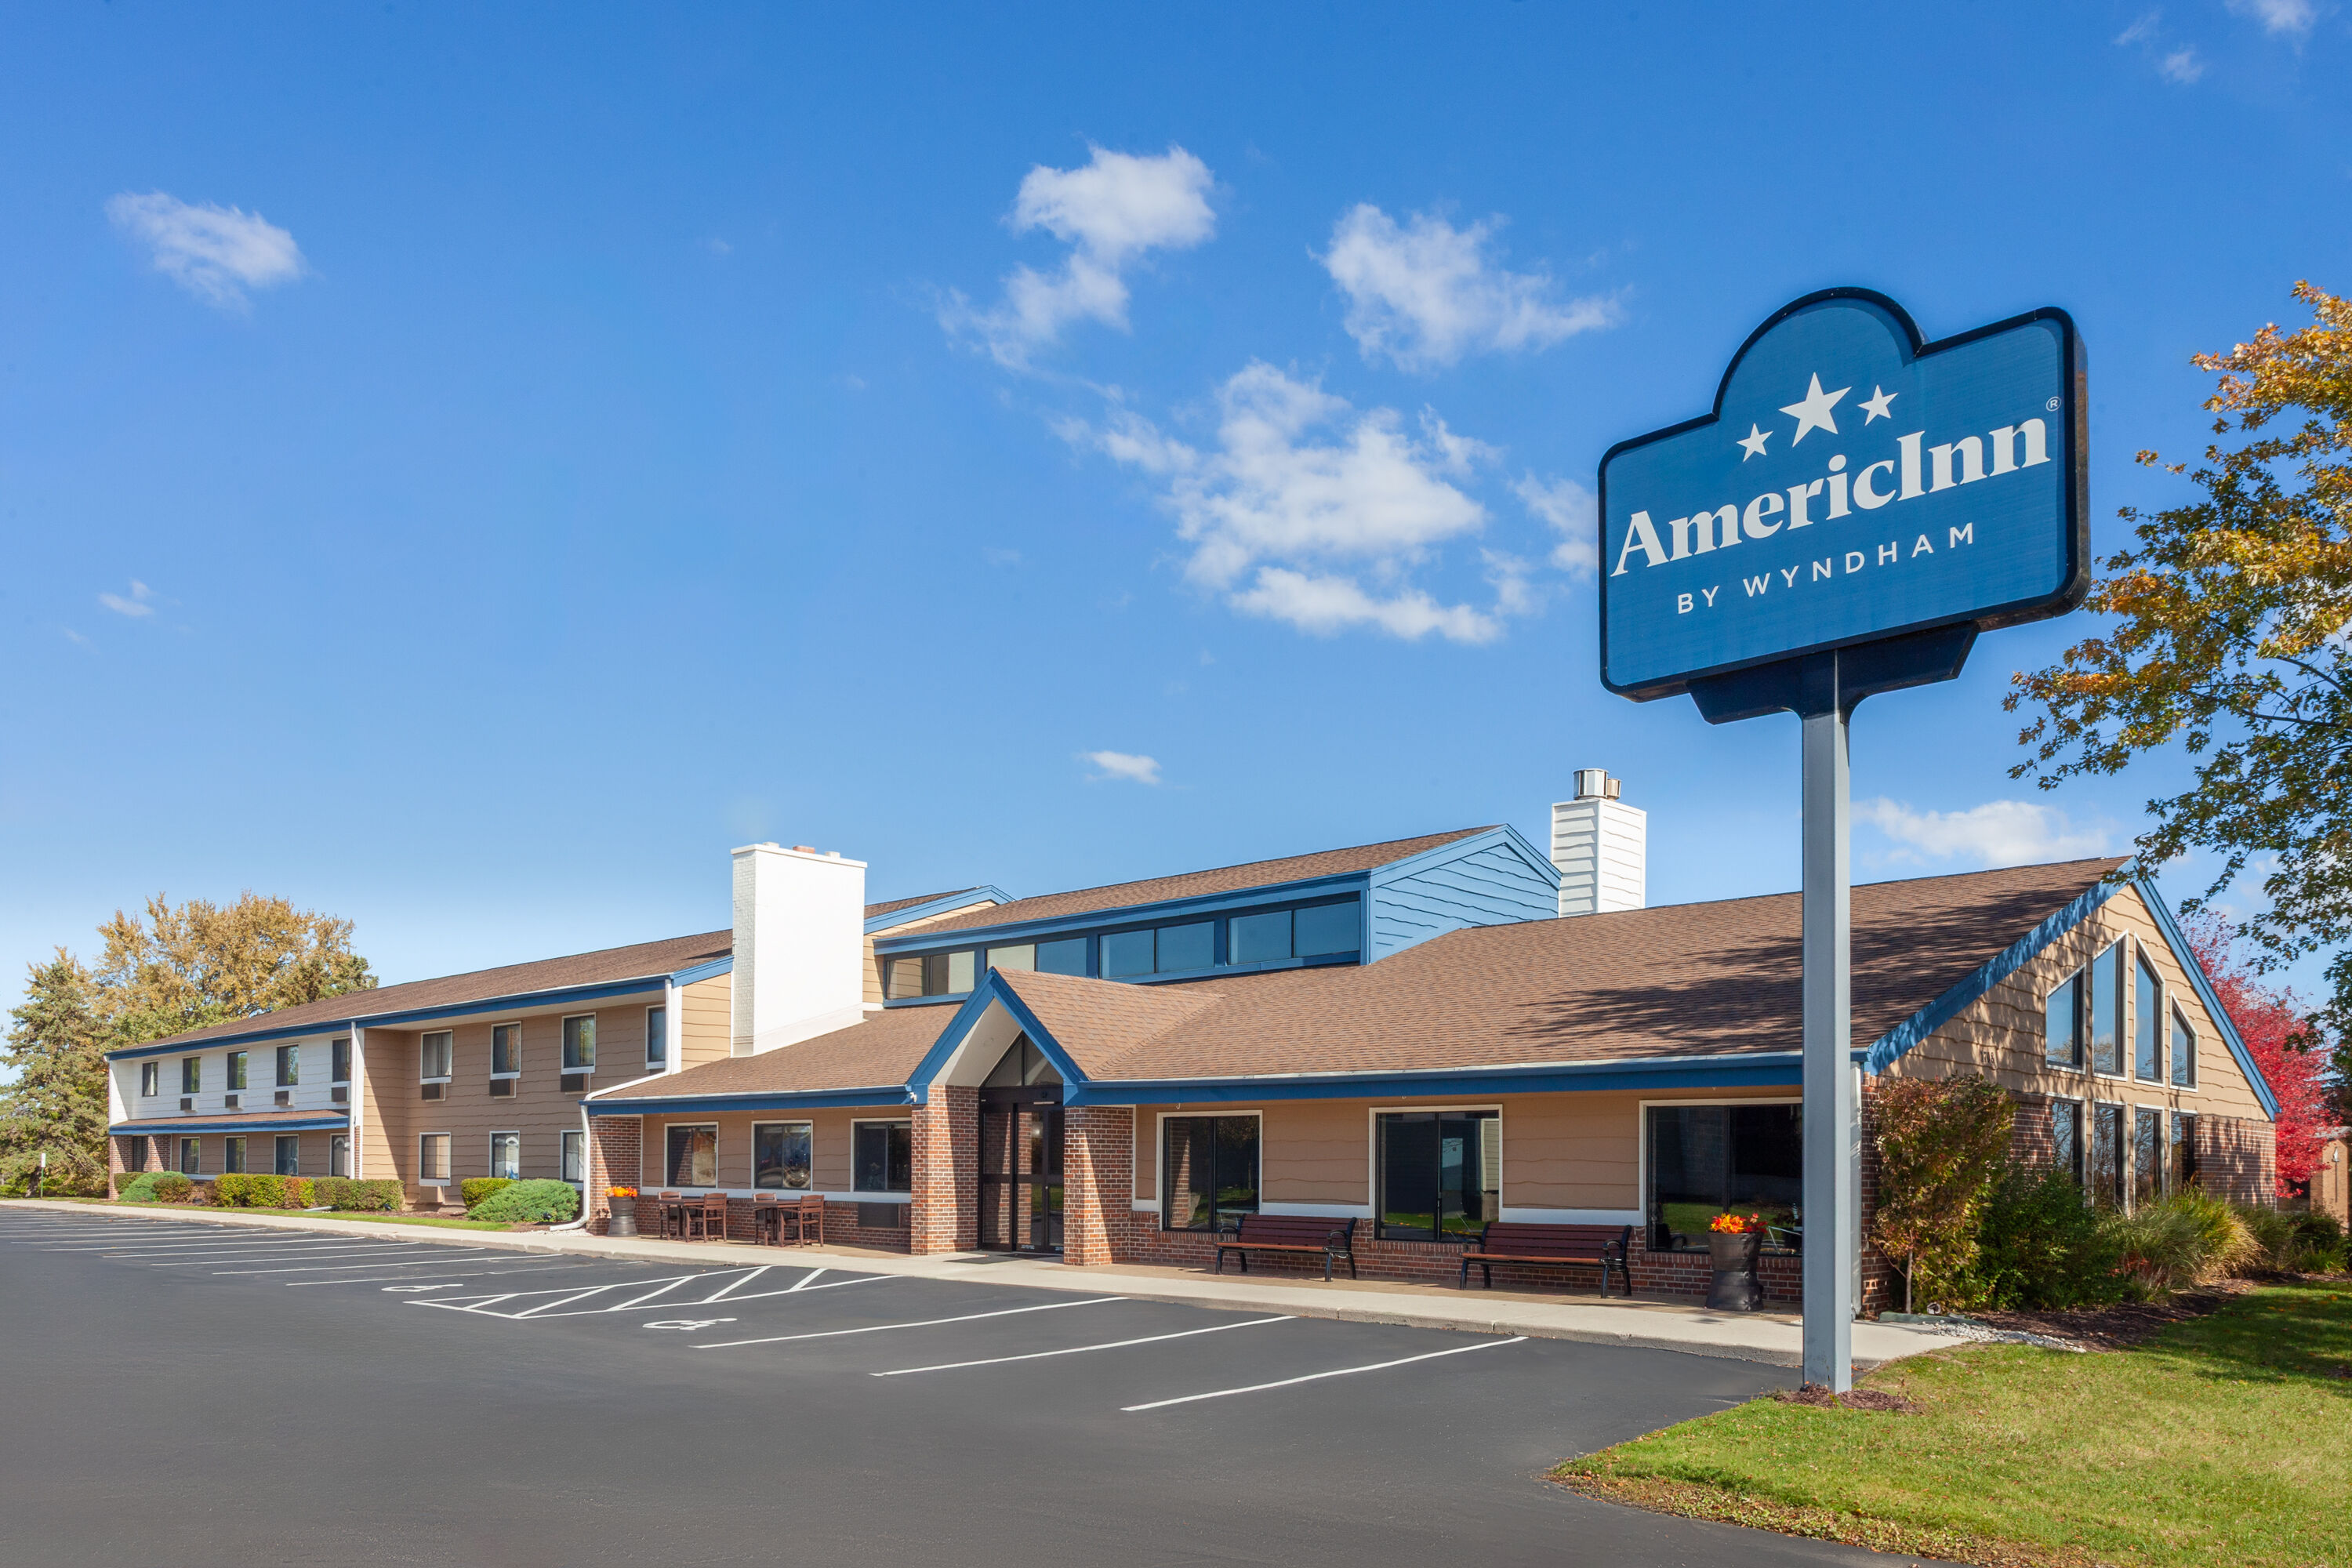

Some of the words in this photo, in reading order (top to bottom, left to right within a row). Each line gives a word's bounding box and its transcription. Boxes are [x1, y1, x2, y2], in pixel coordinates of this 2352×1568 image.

[1610, 418, 2051, 577] AmericInn
[1677, 585, 1720, 615] BY
[1742, 522, 1974, 598] WYNDHAM
